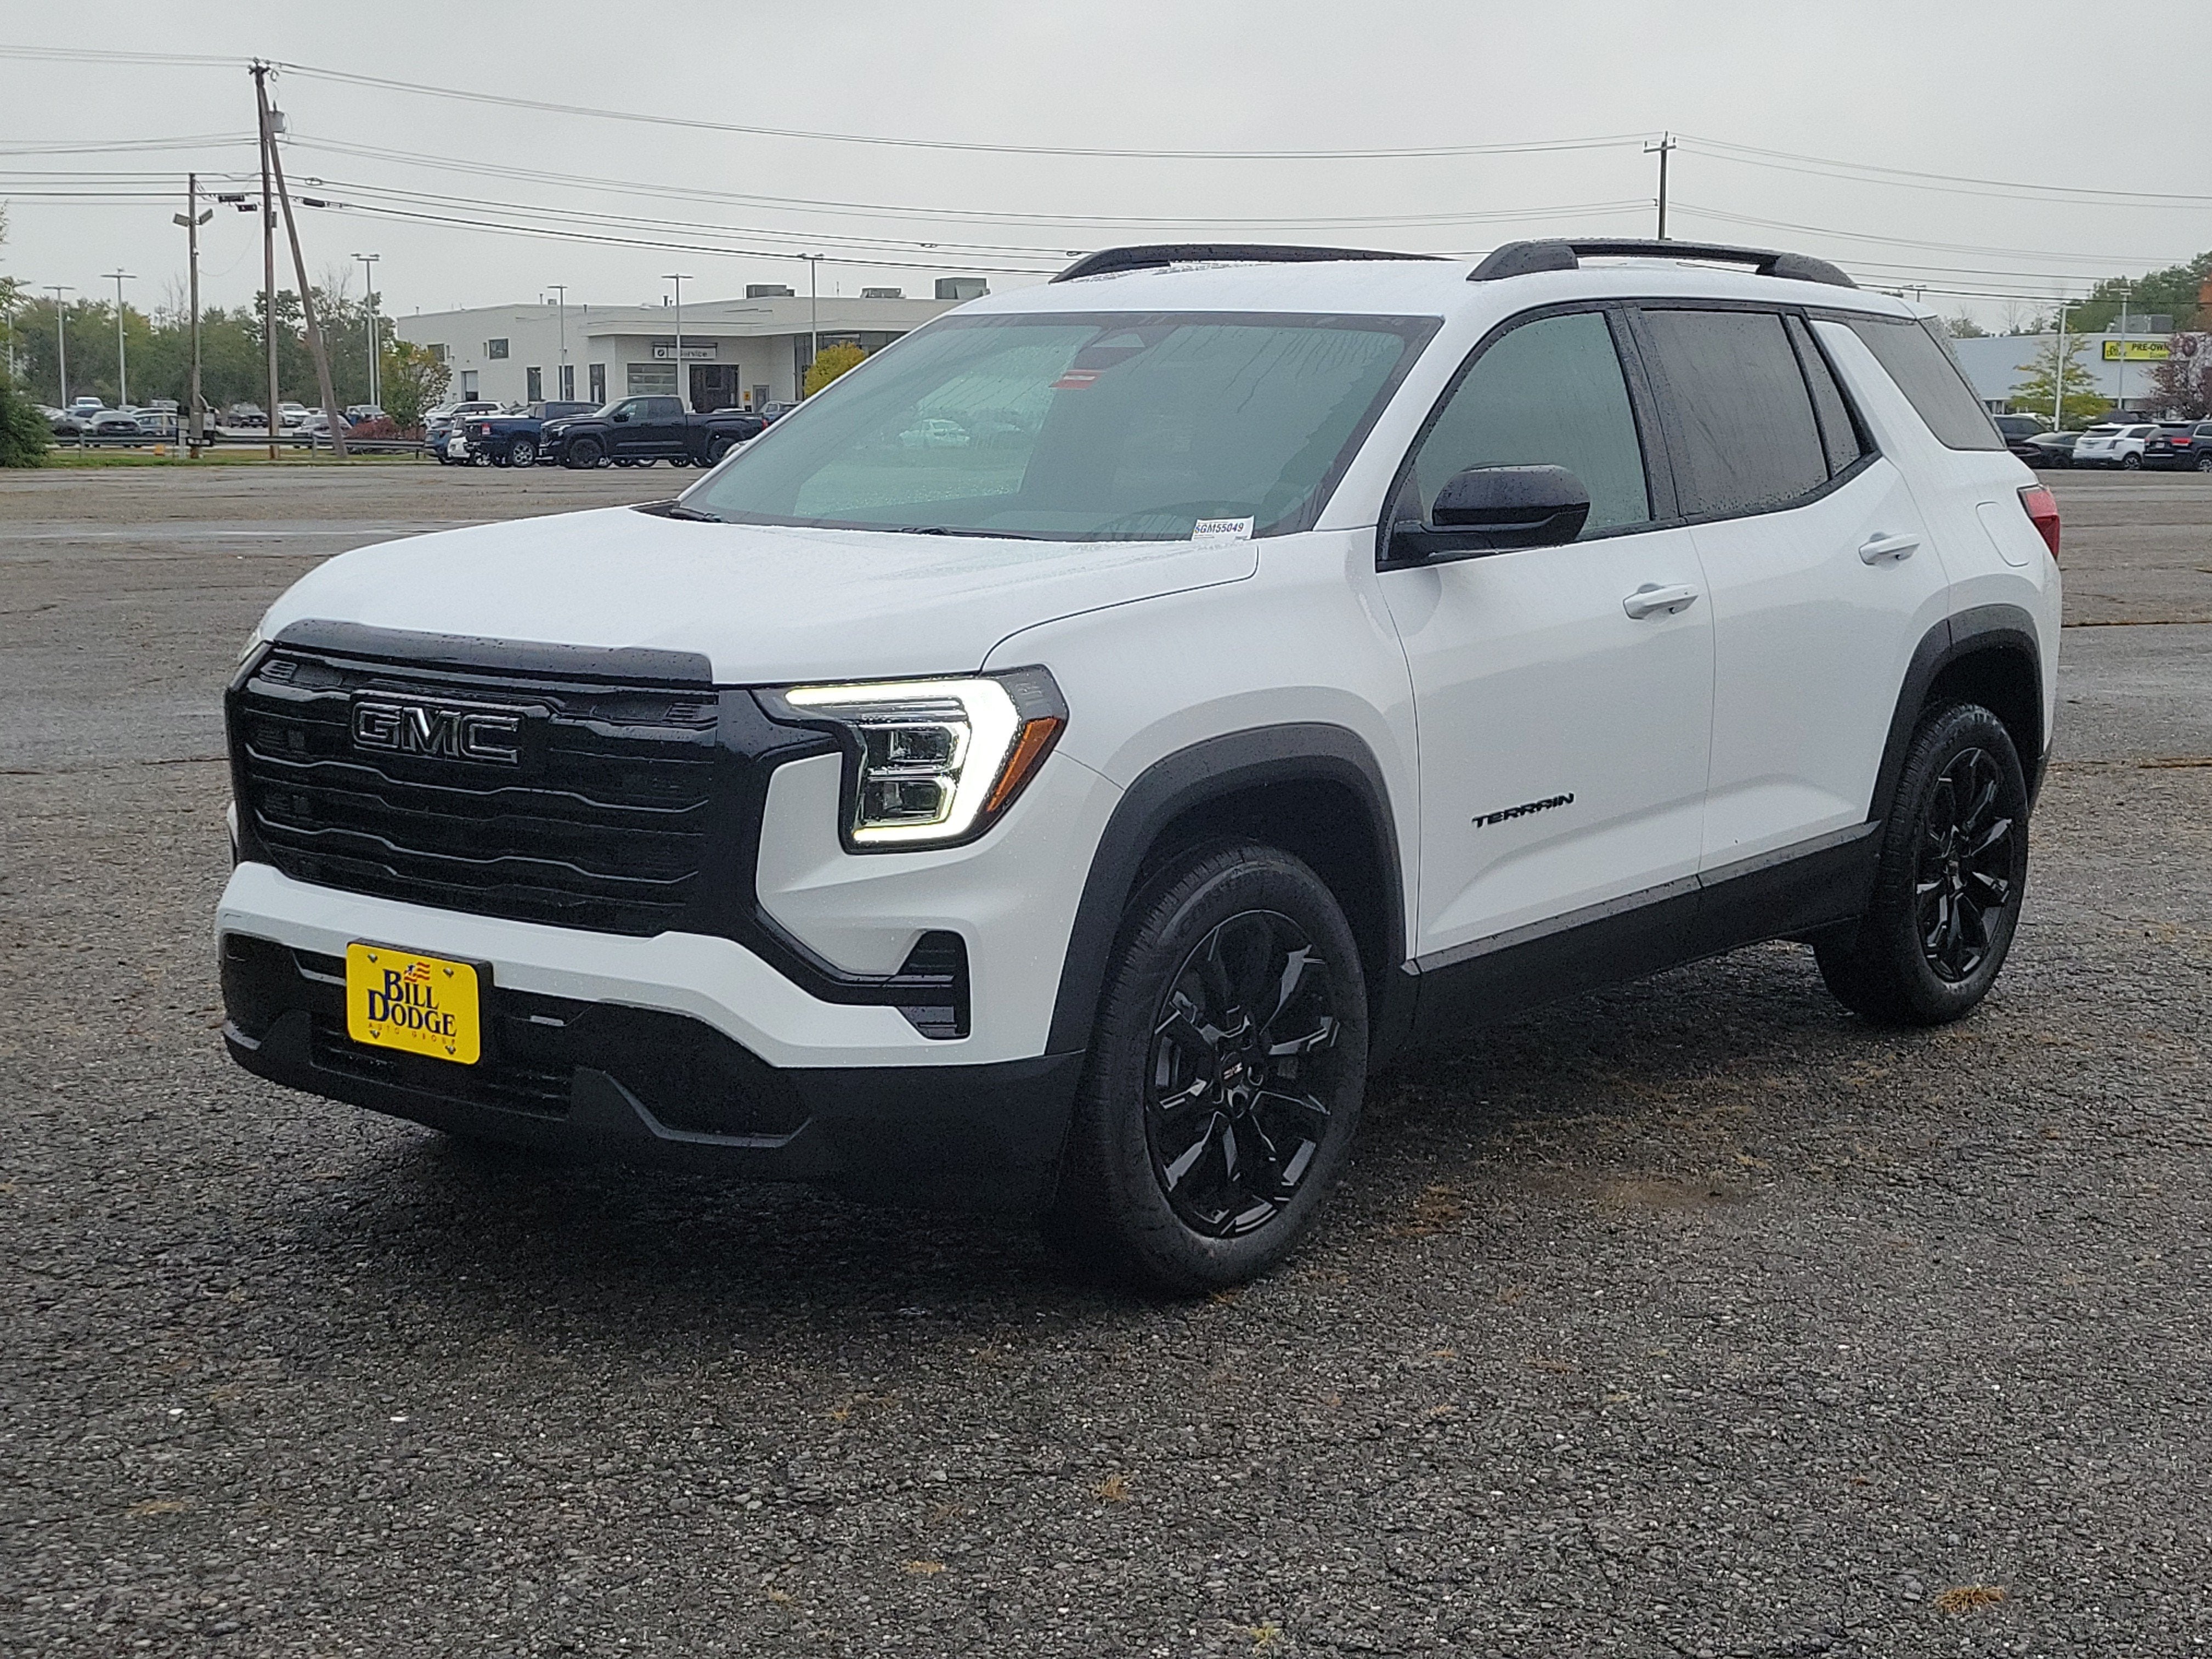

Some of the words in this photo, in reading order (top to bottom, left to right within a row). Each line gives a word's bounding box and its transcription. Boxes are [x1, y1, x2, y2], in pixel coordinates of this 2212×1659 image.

[352, 702, 520, 764] GMC
[1471, 792, 1574, 828] TERRAIN
[382, 969, 439, 1009] BILL
[367, 989, 457, 1037] DODGE
